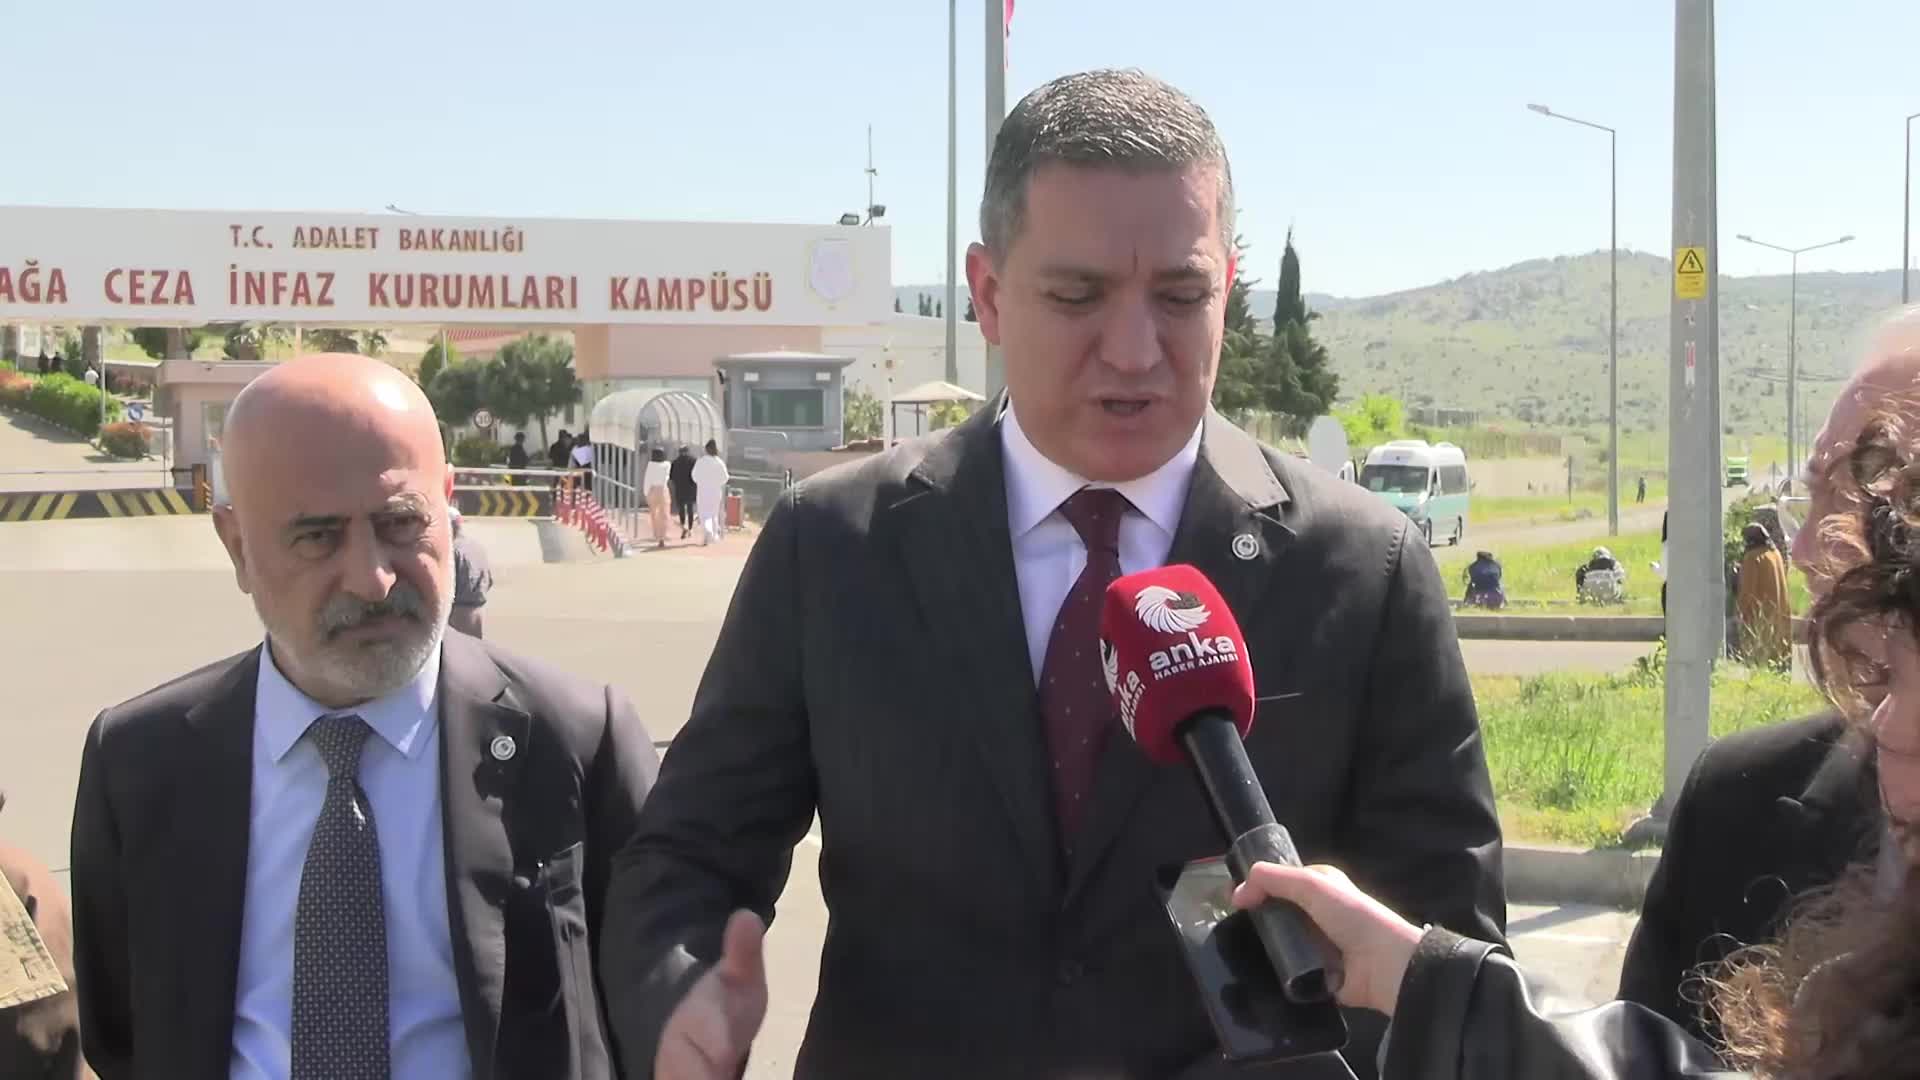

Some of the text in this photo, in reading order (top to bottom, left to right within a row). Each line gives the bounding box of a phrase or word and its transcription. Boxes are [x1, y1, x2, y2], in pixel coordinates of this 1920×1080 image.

[230, 225, 523, 252] T.C. ADALET BAKANLIĞI
[0, 259, 772, 312] AĞA CEZA İNFAZ KURUMLARI KAMPÜSÜ
[1149, 632, 1236, 670] anka
[1154, 653, 1239, 681] HABER AJANSI
